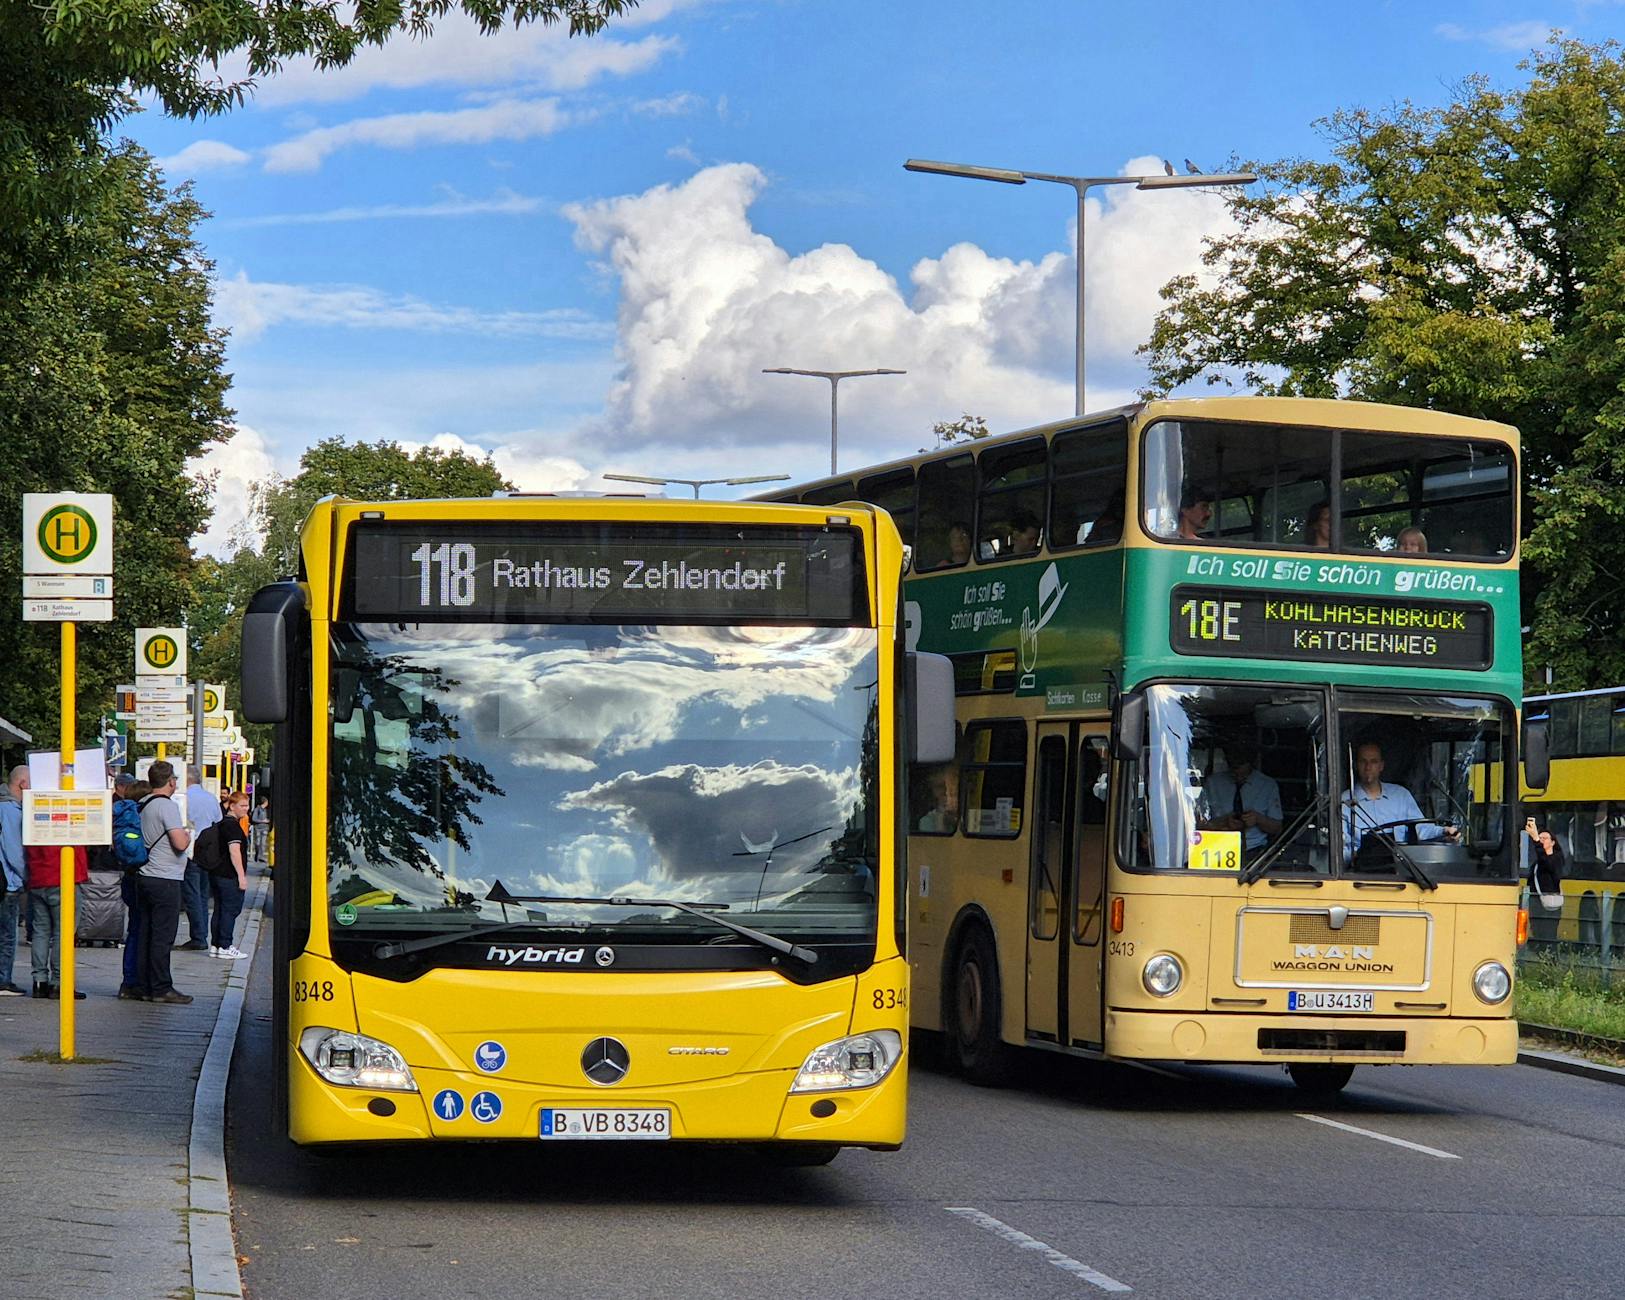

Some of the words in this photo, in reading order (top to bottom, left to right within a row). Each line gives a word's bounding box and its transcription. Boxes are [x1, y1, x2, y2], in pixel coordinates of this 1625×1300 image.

[56, 518, 79, 550] H
[411, 543, 476, 606] 118
[493, 559, 610, 588] Rathaus
[623, 560, 786, 590] Zehlendorf
[1187, 555, 1224, 576] Ich
[1231, 559, 1268, 579] soll
[1272, 561, 1312, 581] Sie
[1317, 564, 1381, 586] schön
[1395, 569, 1504, 592] grüßen...
[963, 585, 977, 604] Ich
[978, 583, 991, 603] soll
[991, 581, 1006, 601] Sie
[950, 609, 973, 630] schön
[1181, 600, 1241, 641] 18E
[154, 643, 168, 661] H
[1201, 849, 1236, 869] 118
[486, 946, 585, 966] hybrid
[1109, 941, 1135, 957] 3413
[1273, 961, 1341, 971] WAGGON
[1345, 963, 1394, 972] UNION
[295, 980, 334, 1002] 8348
[1298, 993, 1307, 1008] B
[554, 1113, 567, 1133] B
[582, 1113, 609, 1133] VB
[614, 1113, 666, 1133] 8348
